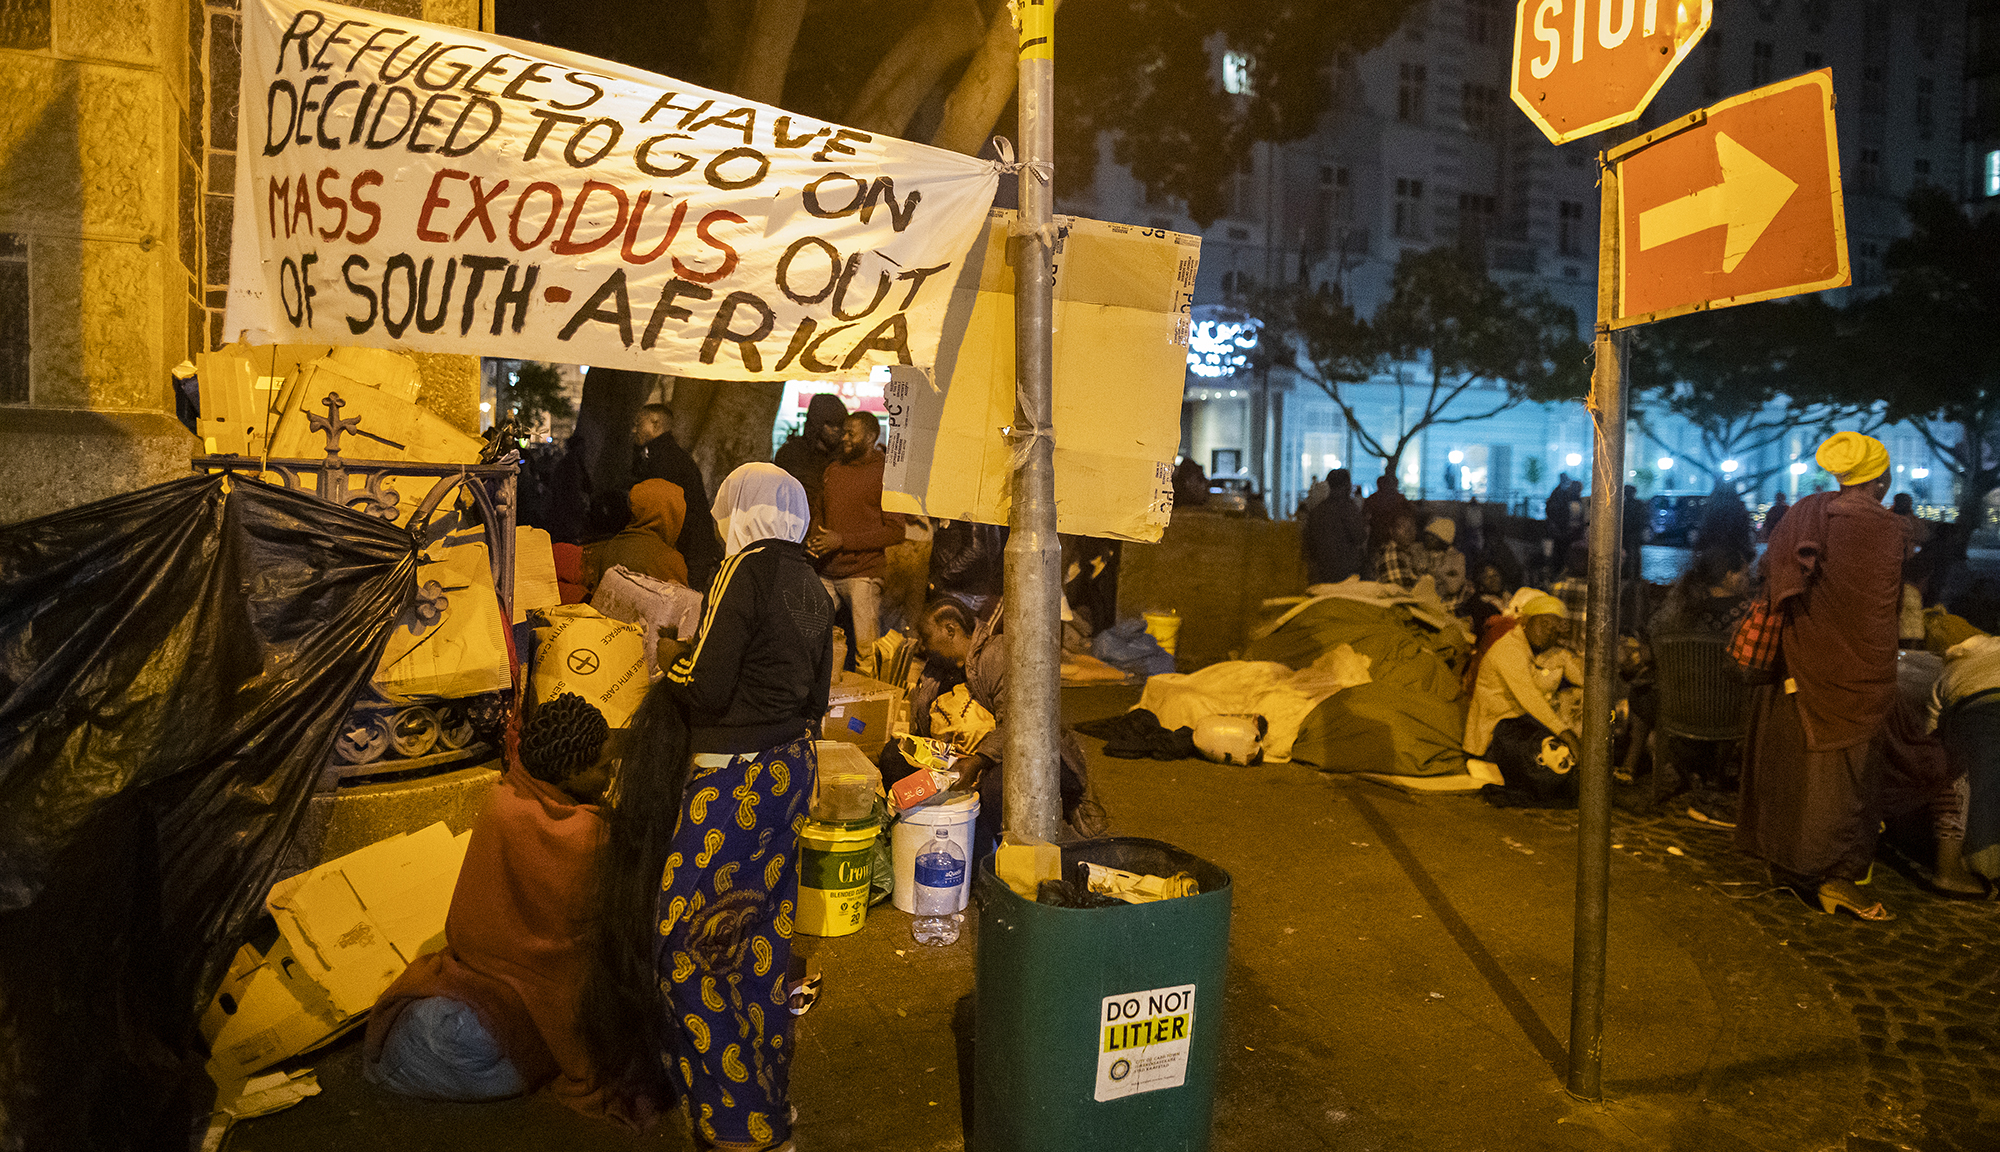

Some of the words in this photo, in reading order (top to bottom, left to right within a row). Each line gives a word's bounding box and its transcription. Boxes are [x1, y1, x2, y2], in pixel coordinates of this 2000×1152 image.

[276, 9, 617, 110] REFUGEES
[640, 92, 872, 162] HAVE
[262, 75, 501, 158] DECIDED
[523, 109, 624, 168] TO
[634, 133, 771, 190] GO
[802, 172, 921, 232] ON
[269, 167, 383, 244] MASS
[417, 168, 748, 284] EXODUS
[776, 236, 950, 322] OUT
[281, 251, 318, 329] OF
[888, 404, 902, 427] PC
[599, 684, 620, 703] CARE
[619, 668, 634, 686] WITH
[1106, 999, 1140, 1022] DO
[1149, 990, 1191, 1016] NOT
[1109, 1016, 1184, 1051] LITTER
